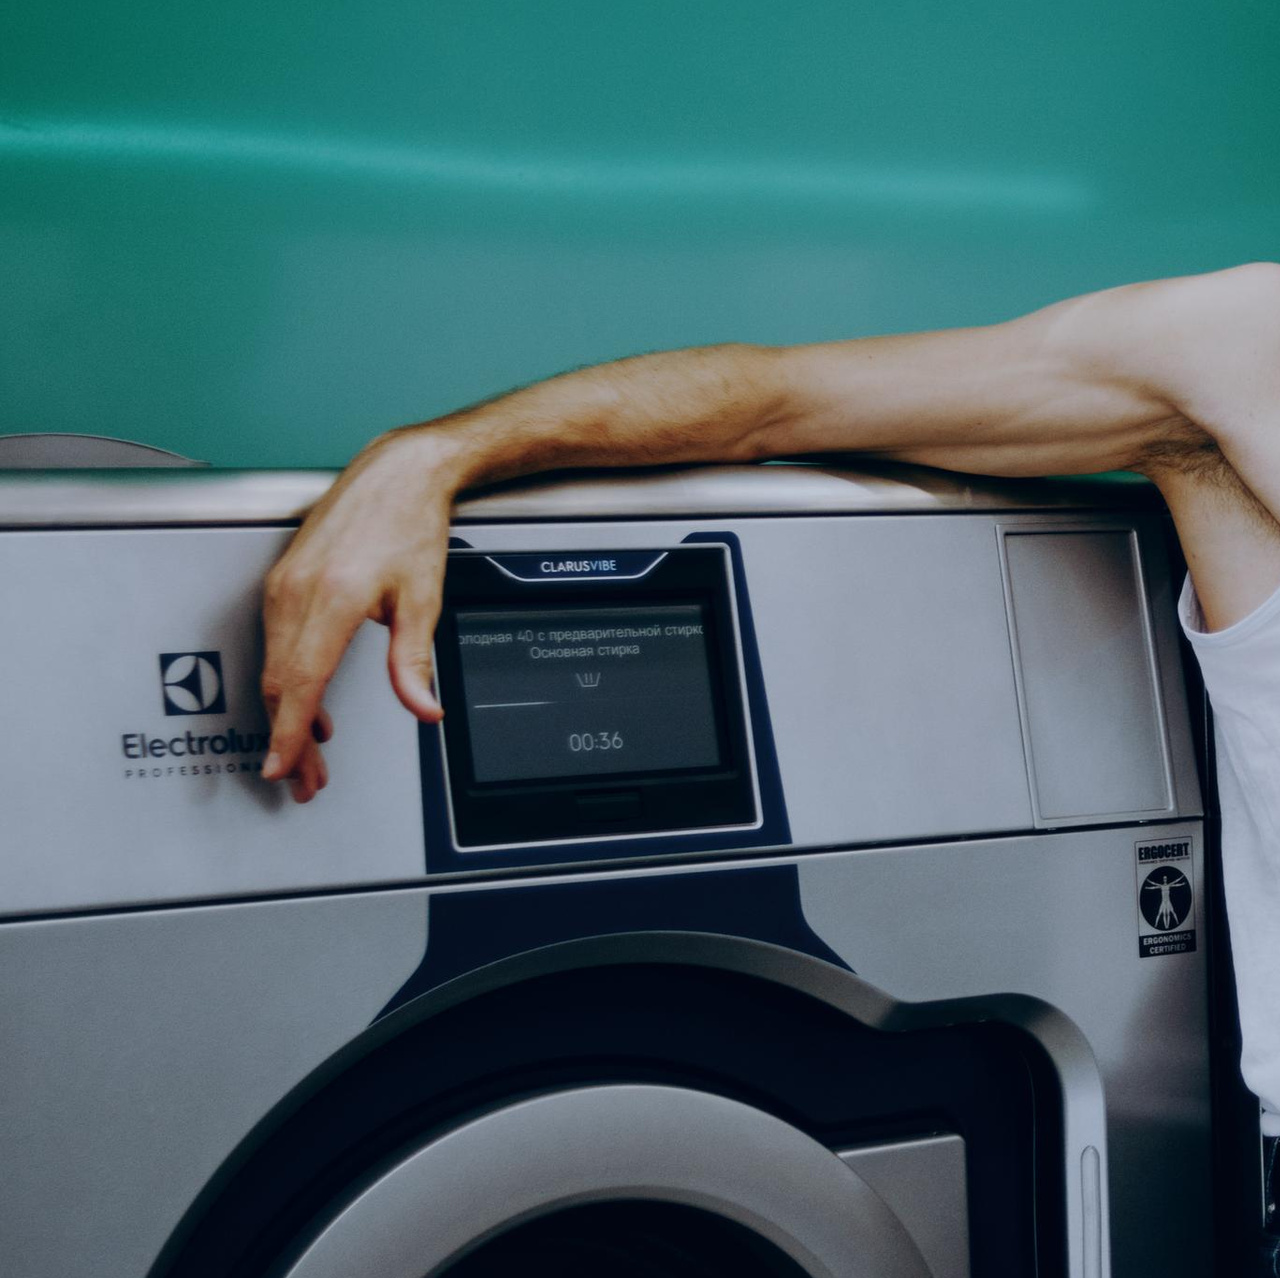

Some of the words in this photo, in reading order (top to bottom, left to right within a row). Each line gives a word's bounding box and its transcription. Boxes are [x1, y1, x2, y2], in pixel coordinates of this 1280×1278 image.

[540, 559, 617, 574] CLARUSVIBE
[517, 629, 534, 642] 40
[537, 631, 546, 641] с
[549, 624, 661, 643] предварительной
[530, 646, 594, 660] Основная
[597, 644, 640, 658] стирка
[569, 732, 624, 752] 00:36
[1138, 842, 1190, 861] ERGOCERT
[1143, 933, 1192, 946] ERGONOMICS
[1149, 943, 1187, 955] CERTIFIED
